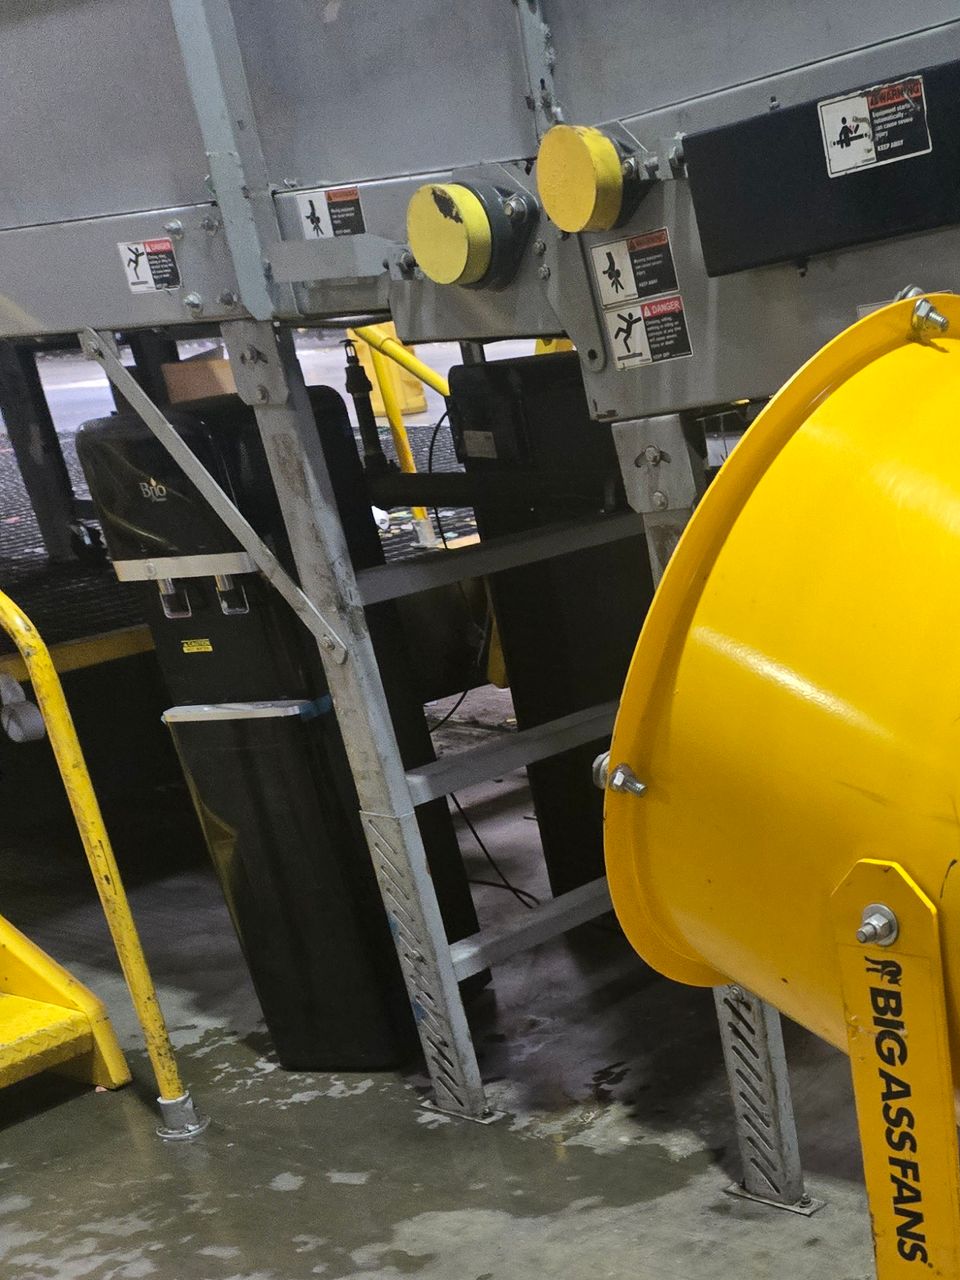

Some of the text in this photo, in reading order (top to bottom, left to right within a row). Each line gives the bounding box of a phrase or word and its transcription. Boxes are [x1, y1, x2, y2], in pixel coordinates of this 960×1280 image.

[651, 300, 681, 315] DANGER
[139, 478, 167, 498] Brio
[870, 987, 928, 1265] BIG ASS FANS
